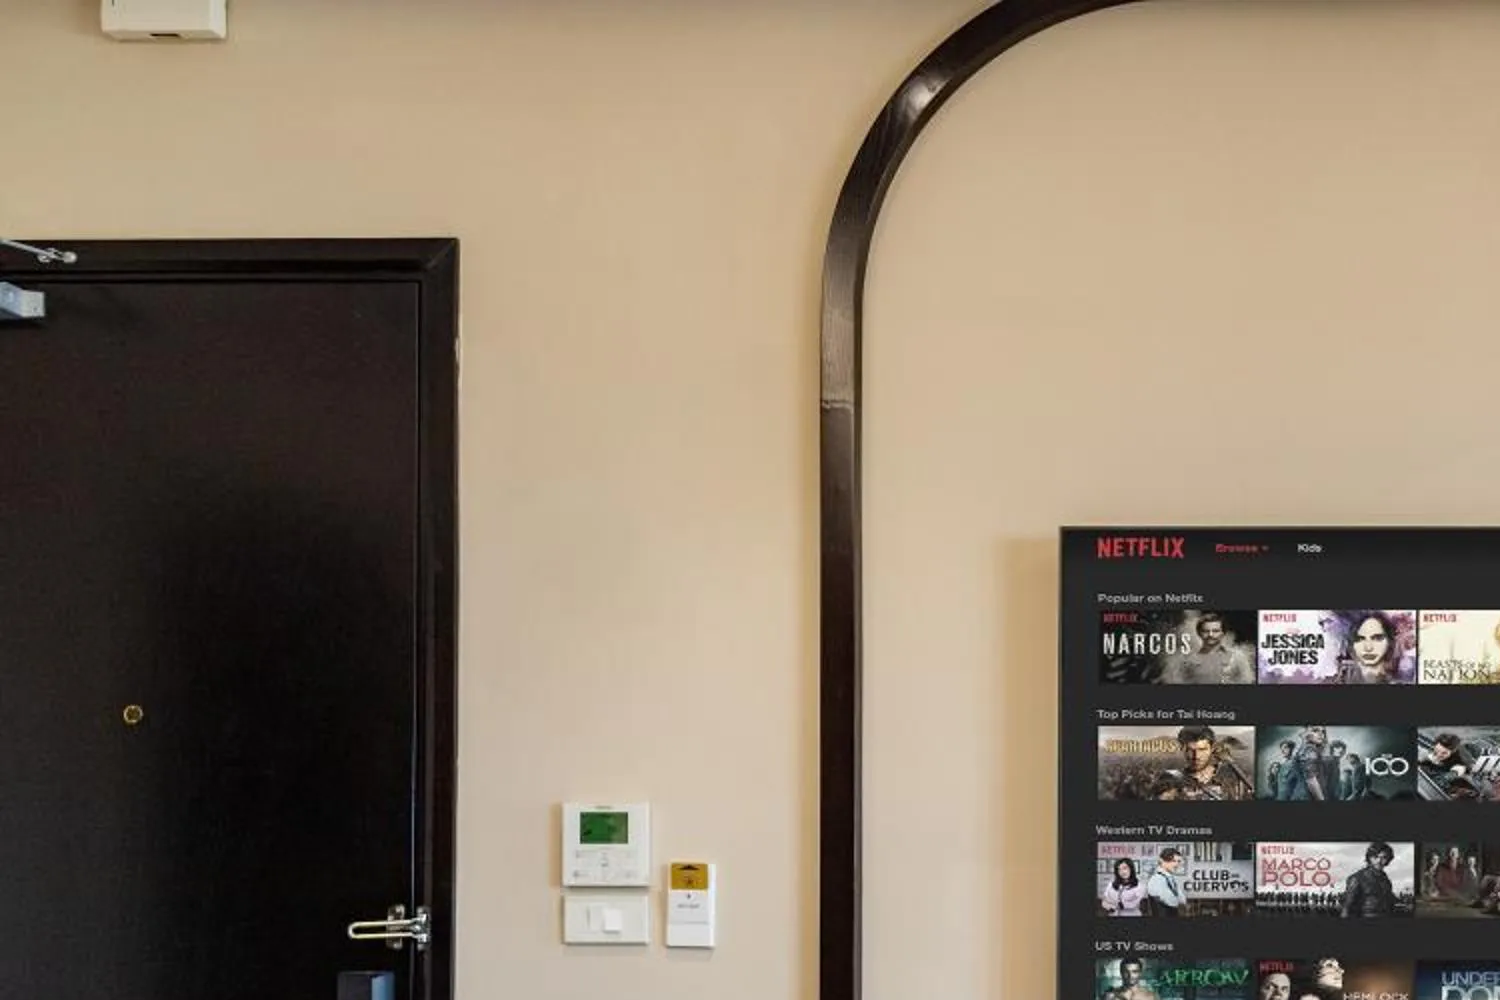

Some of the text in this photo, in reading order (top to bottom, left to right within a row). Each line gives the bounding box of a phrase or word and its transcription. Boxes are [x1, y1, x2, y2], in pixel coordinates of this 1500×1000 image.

[1097, 537, 1185, 559] NETFLIX
[1215, 543, 1258, 553] Browse
[1297, 543, 1323, 553] Kids
[1098, 593, 1204, 604] Popular on Netflix
[1263, 613, 1297, 622] NETFLIX
[1103, 634, 1192, 655] NARCOS
[1262, 634, 1325, 649] JESSICA
[1268, 650, 1319, 665] JONES
[1096, 709, 1118, 720] Top
[1121, 709, 1153, 719] Picks
[1157, 709, 1174, 718] for
[1095, 825, 1213, 836] Western TV Dramas
[1261, 858, 1332, 871] MARCO
[1192, 869, 1230, 881] CLUB
[1095, 941, 1174, 951] US TV Shows
